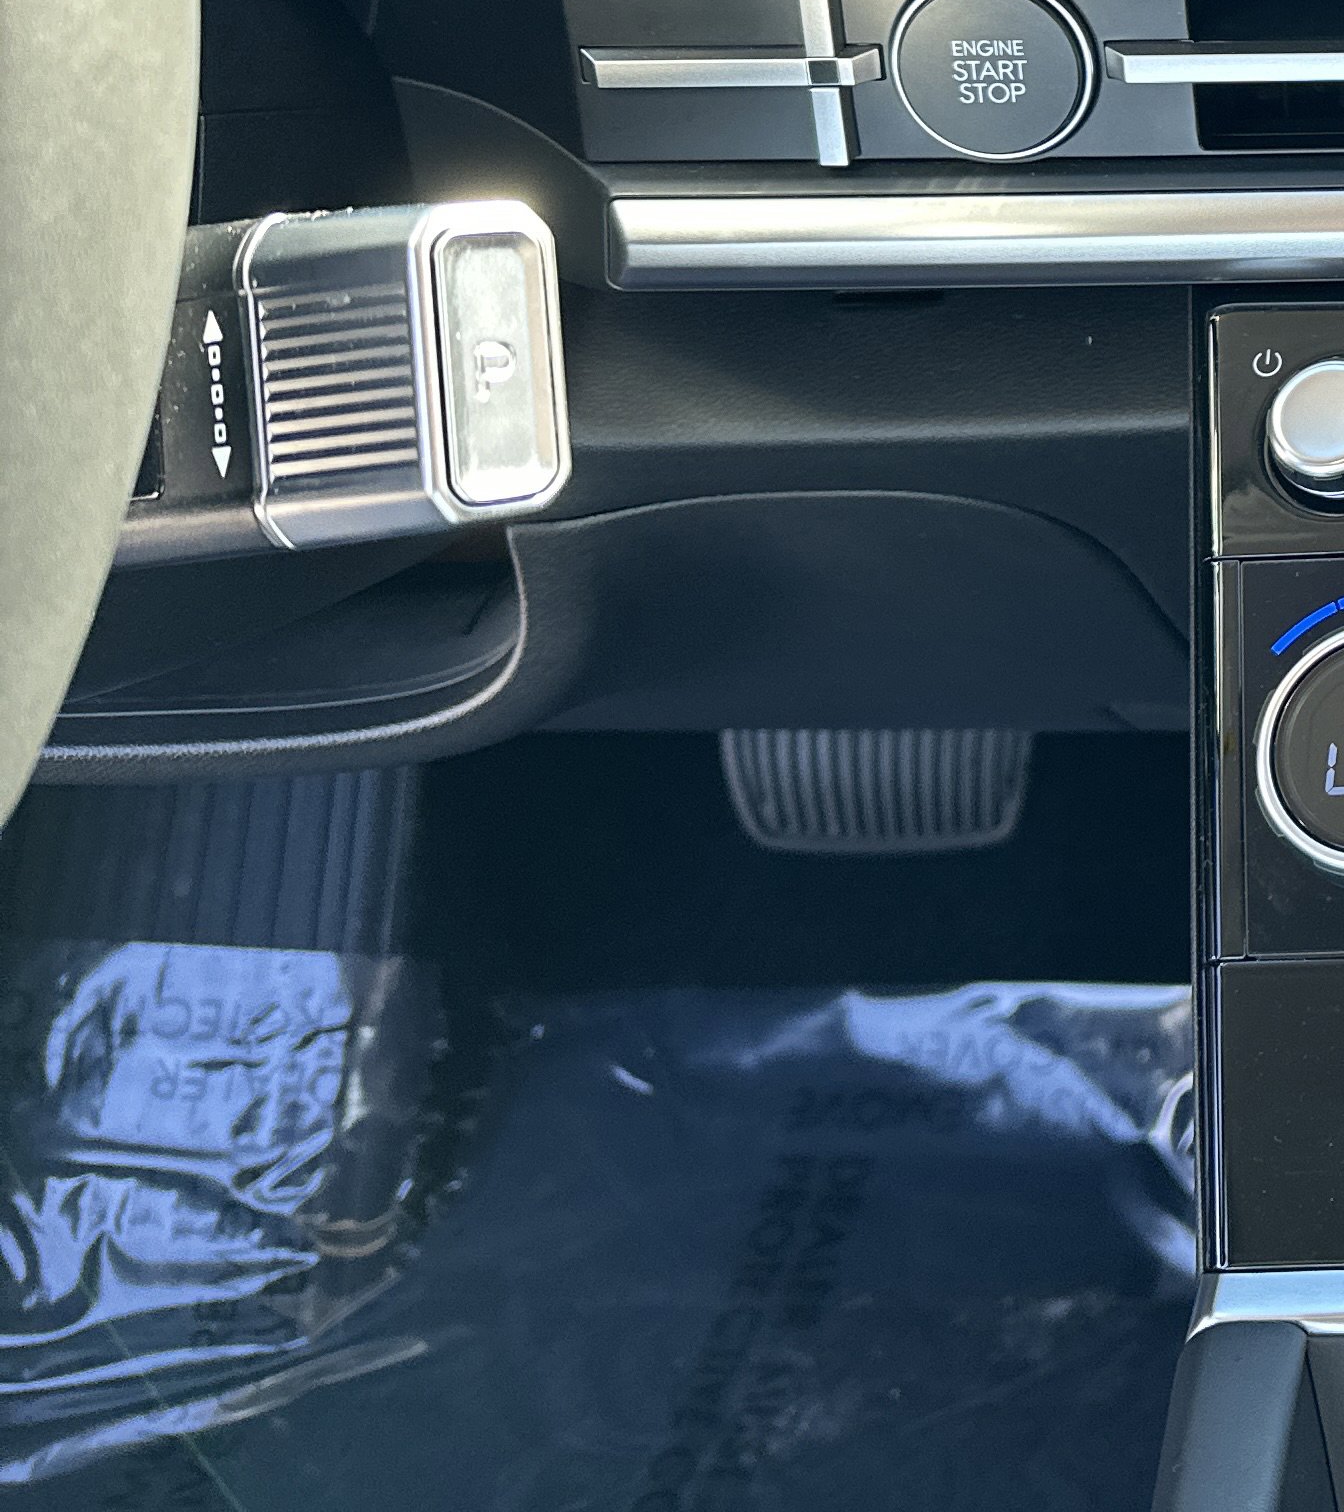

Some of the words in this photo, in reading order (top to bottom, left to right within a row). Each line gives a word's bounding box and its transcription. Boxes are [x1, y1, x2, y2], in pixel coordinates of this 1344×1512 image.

[950, 39, 1025, 57] ENGINE
[951, 59, 1028, 82] START
[959, 82, 1026, 104] STOP
